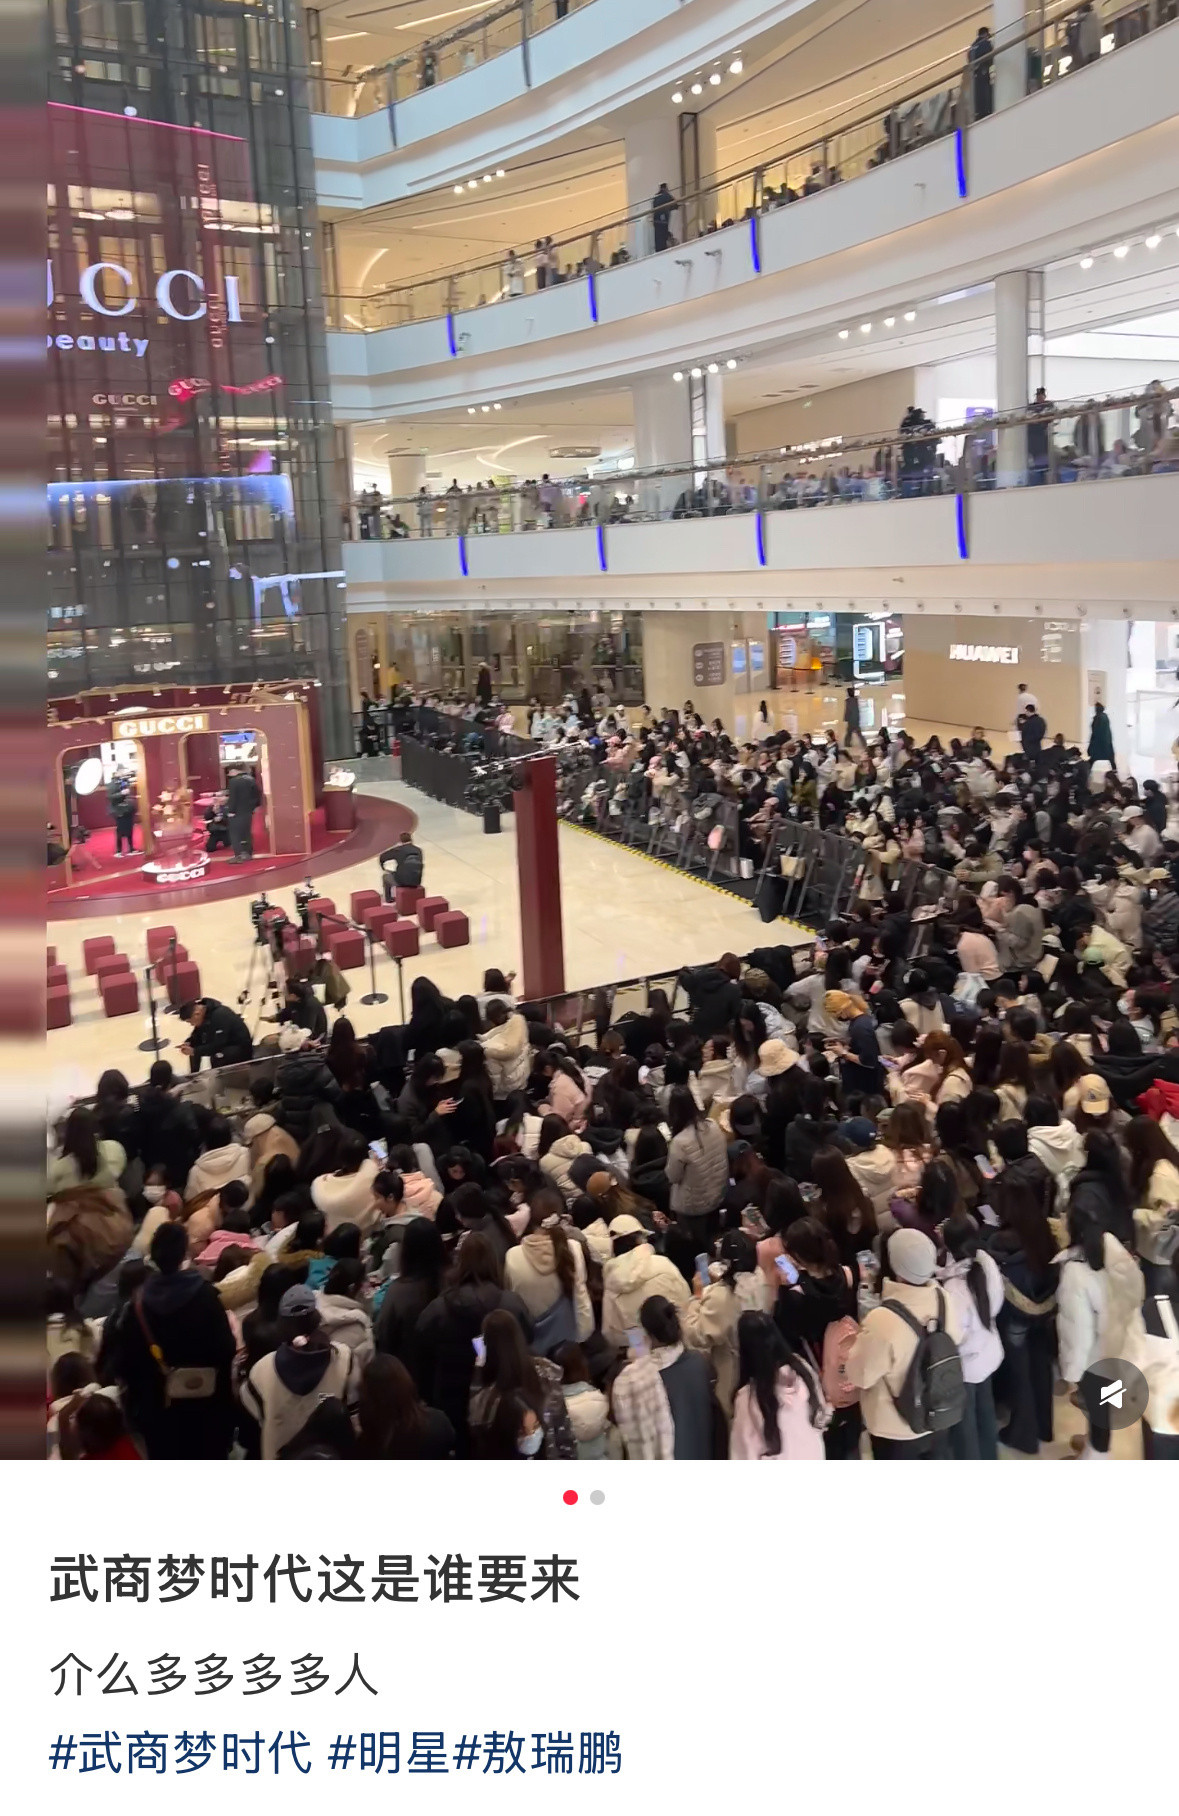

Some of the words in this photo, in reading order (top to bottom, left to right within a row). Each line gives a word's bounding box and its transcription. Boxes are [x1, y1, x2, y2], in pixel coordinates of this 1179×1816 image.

[92, 393, 158, 406] GUCCI
[949, 644, 1019, 664] HUAWEI
[118, 714, 204, 738] GUCCI
